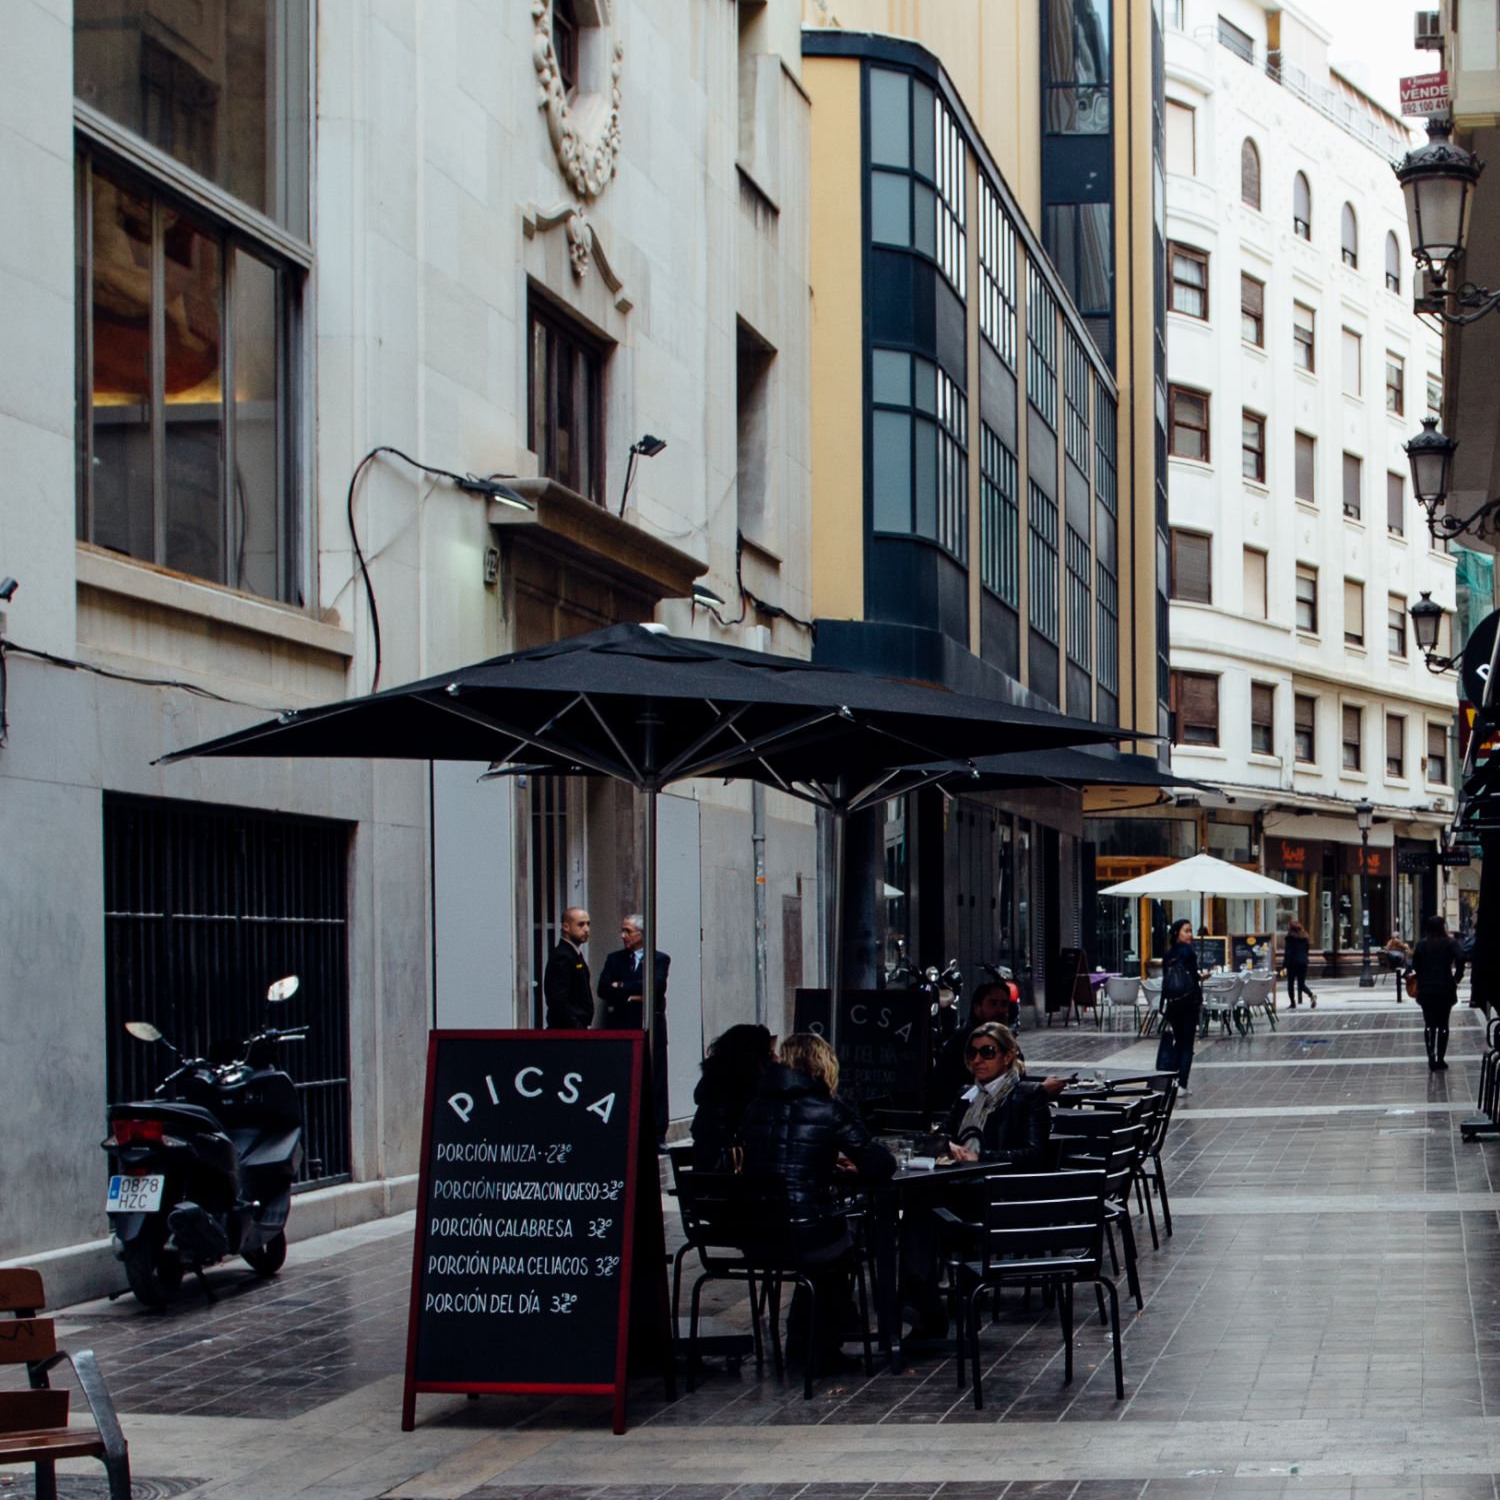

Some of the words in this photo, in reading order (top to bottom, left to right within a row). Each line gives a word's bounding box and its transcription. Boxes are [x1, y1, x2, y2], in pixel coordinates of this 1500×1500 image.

[1401, 84, 1449, 101] VENDE
[1419, 100, 1433, 112] 100
[447, 1066, 617, 1124] PICSA
[437, 1138, 497, 1163] PORCIÓN
[500, 1144, 537, 1163] MUZA
[121, 1178, 159, 1193] 0878
[434, 1176, 496, 1200] PORCIÓN
[496, 1182, 541, 1200] FUGAZZA
[541, 1182, 563, 1200] CON
[564, 1182, 599, 1201] QUESO
[119, 1194, 147, 1209] HZC
[431, 1213, 492, 1238] PORCIÓN
[495, 1218, 573, 1238] CALABRESA
[428, 1250, 490, 1275] PORCIÓN
[492, 1255, 525, 1275] PARA
[527, 1255, 588, 1275] CELIACOS
[425, 1287, 487, 1314] PORCIÓN
[490, 1294, 514, 1314] DEL
[519, 1288, 540, 1314] DÍA
